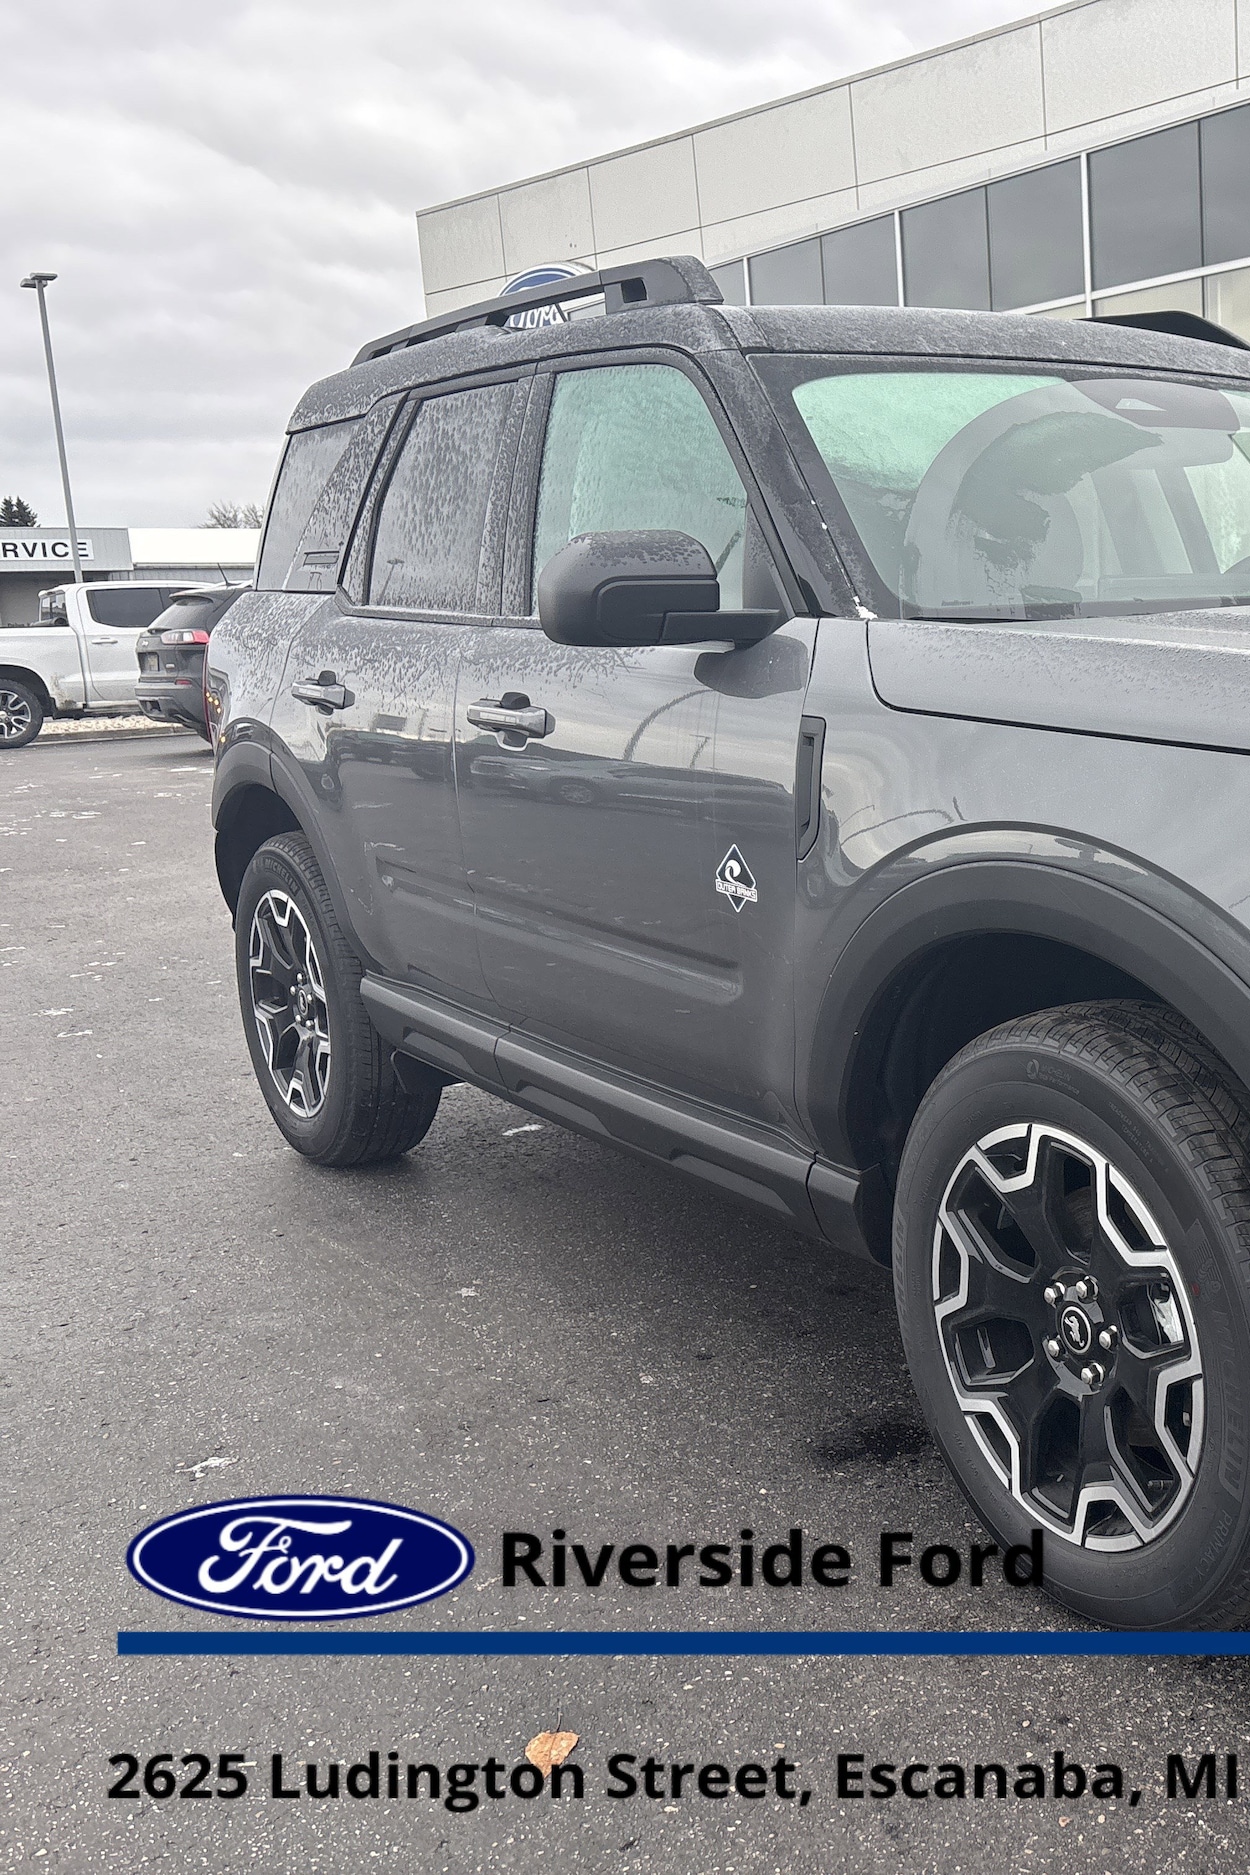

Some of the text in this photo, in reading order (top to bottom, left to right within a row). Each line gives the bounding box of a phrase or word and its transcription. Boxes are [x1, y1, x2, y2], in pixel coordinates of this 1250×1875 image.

[1, 542, 89, 558] RVICE
[717, 881, 757, 899] OUTER BANKS
